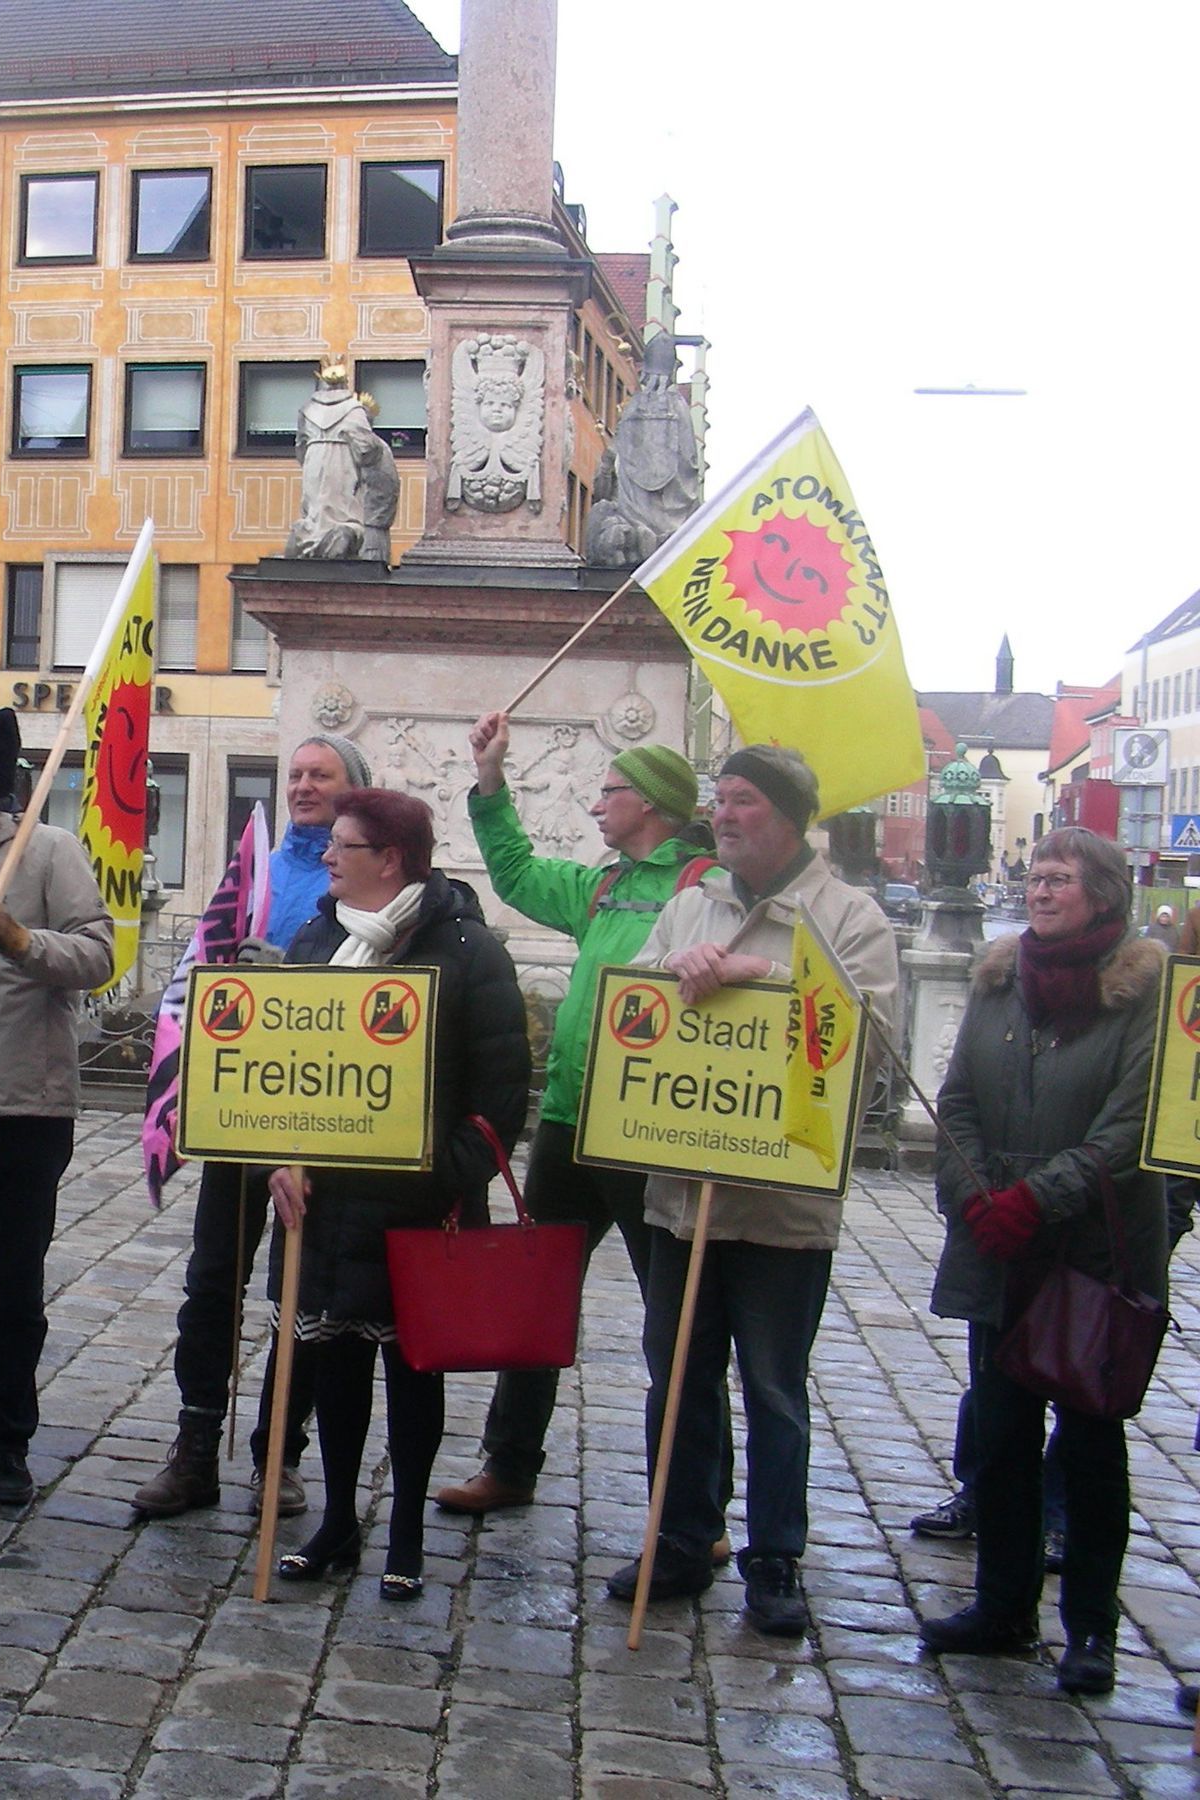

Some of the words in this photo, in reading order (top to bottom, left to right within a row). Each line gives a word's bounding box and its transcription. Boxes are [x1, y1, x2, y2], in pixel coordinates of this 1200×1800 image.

[683, 556, 719, 627] NEIN
[701, 615, 837, 672] DANKE
[262, 996, 346, 1032] Stadt
[677, 1008, 770, 1052] Stadt
[213, 1047, 393, 1112] Freising
[619, 1055, 784, 1121] Freisin
[218, 1108, 374, 1135] Universitätsstadt
[622, 1118, 791, 1160] Universitätsstadt
